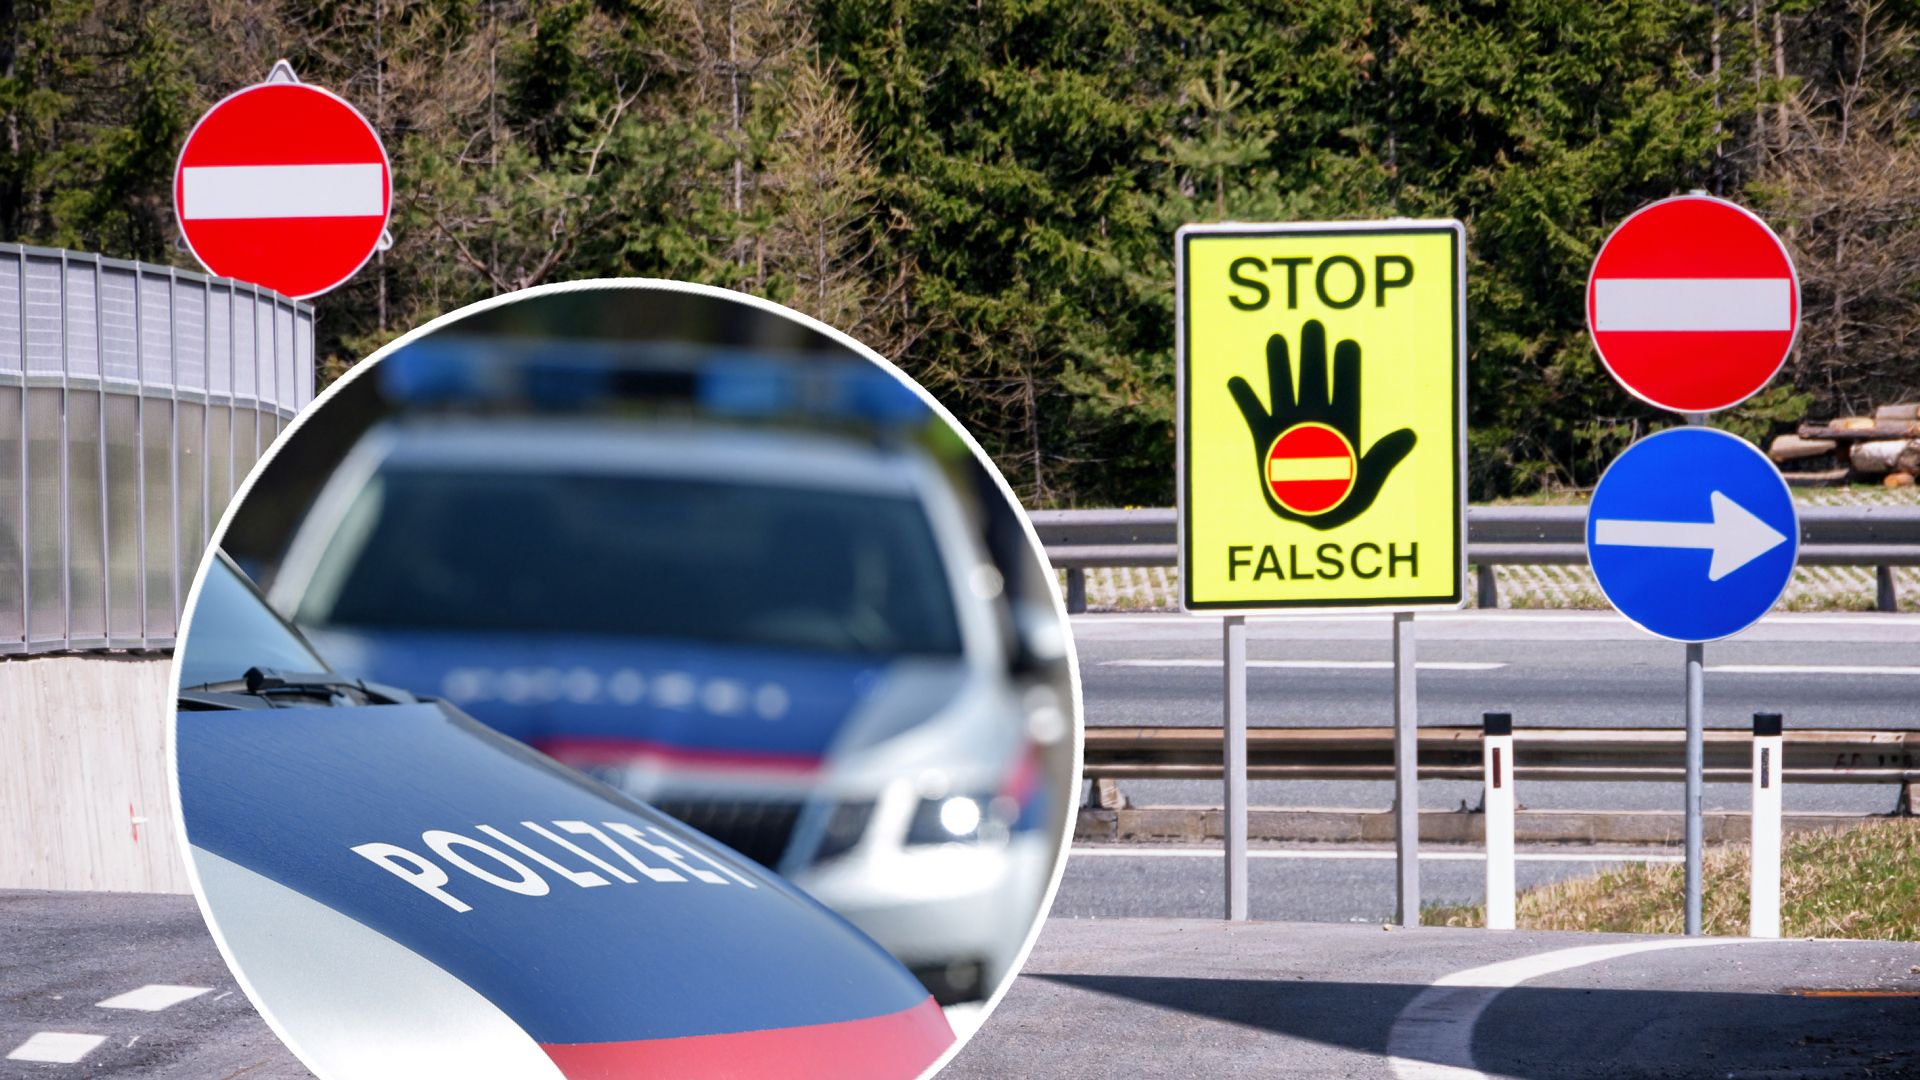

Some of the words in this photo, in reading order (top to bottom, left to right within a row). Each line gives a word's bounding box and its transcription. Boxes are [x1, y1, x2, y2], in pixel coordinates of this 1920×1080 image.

[1228, 255, 1414, 311] STOP
[1228, 542, 1418, 581] FALSCH
[350, 821, 758, 913] POLIZEI
